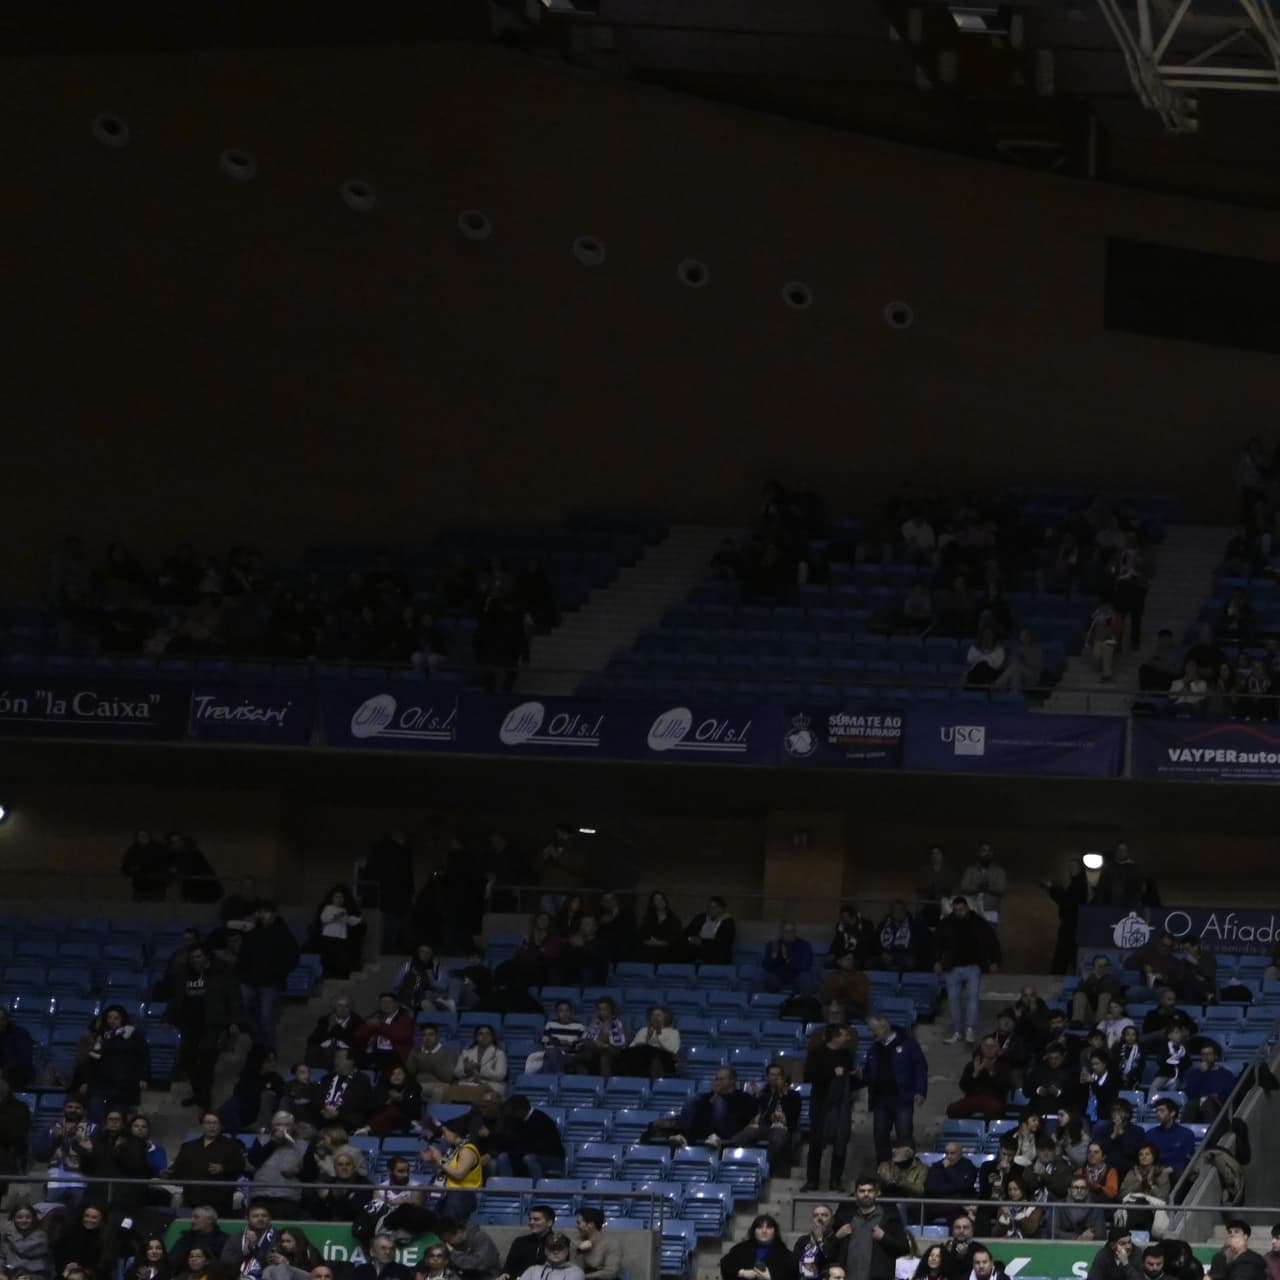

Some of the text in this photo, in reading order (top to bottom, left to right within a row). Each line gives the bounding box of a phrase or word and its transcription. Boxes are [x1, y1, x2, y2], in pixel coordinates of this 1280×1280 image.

[940, 726, 983, 743] USC
[1164, 911, 1192, 936] O
[323, 1239, 368, 1262] ÍDA
